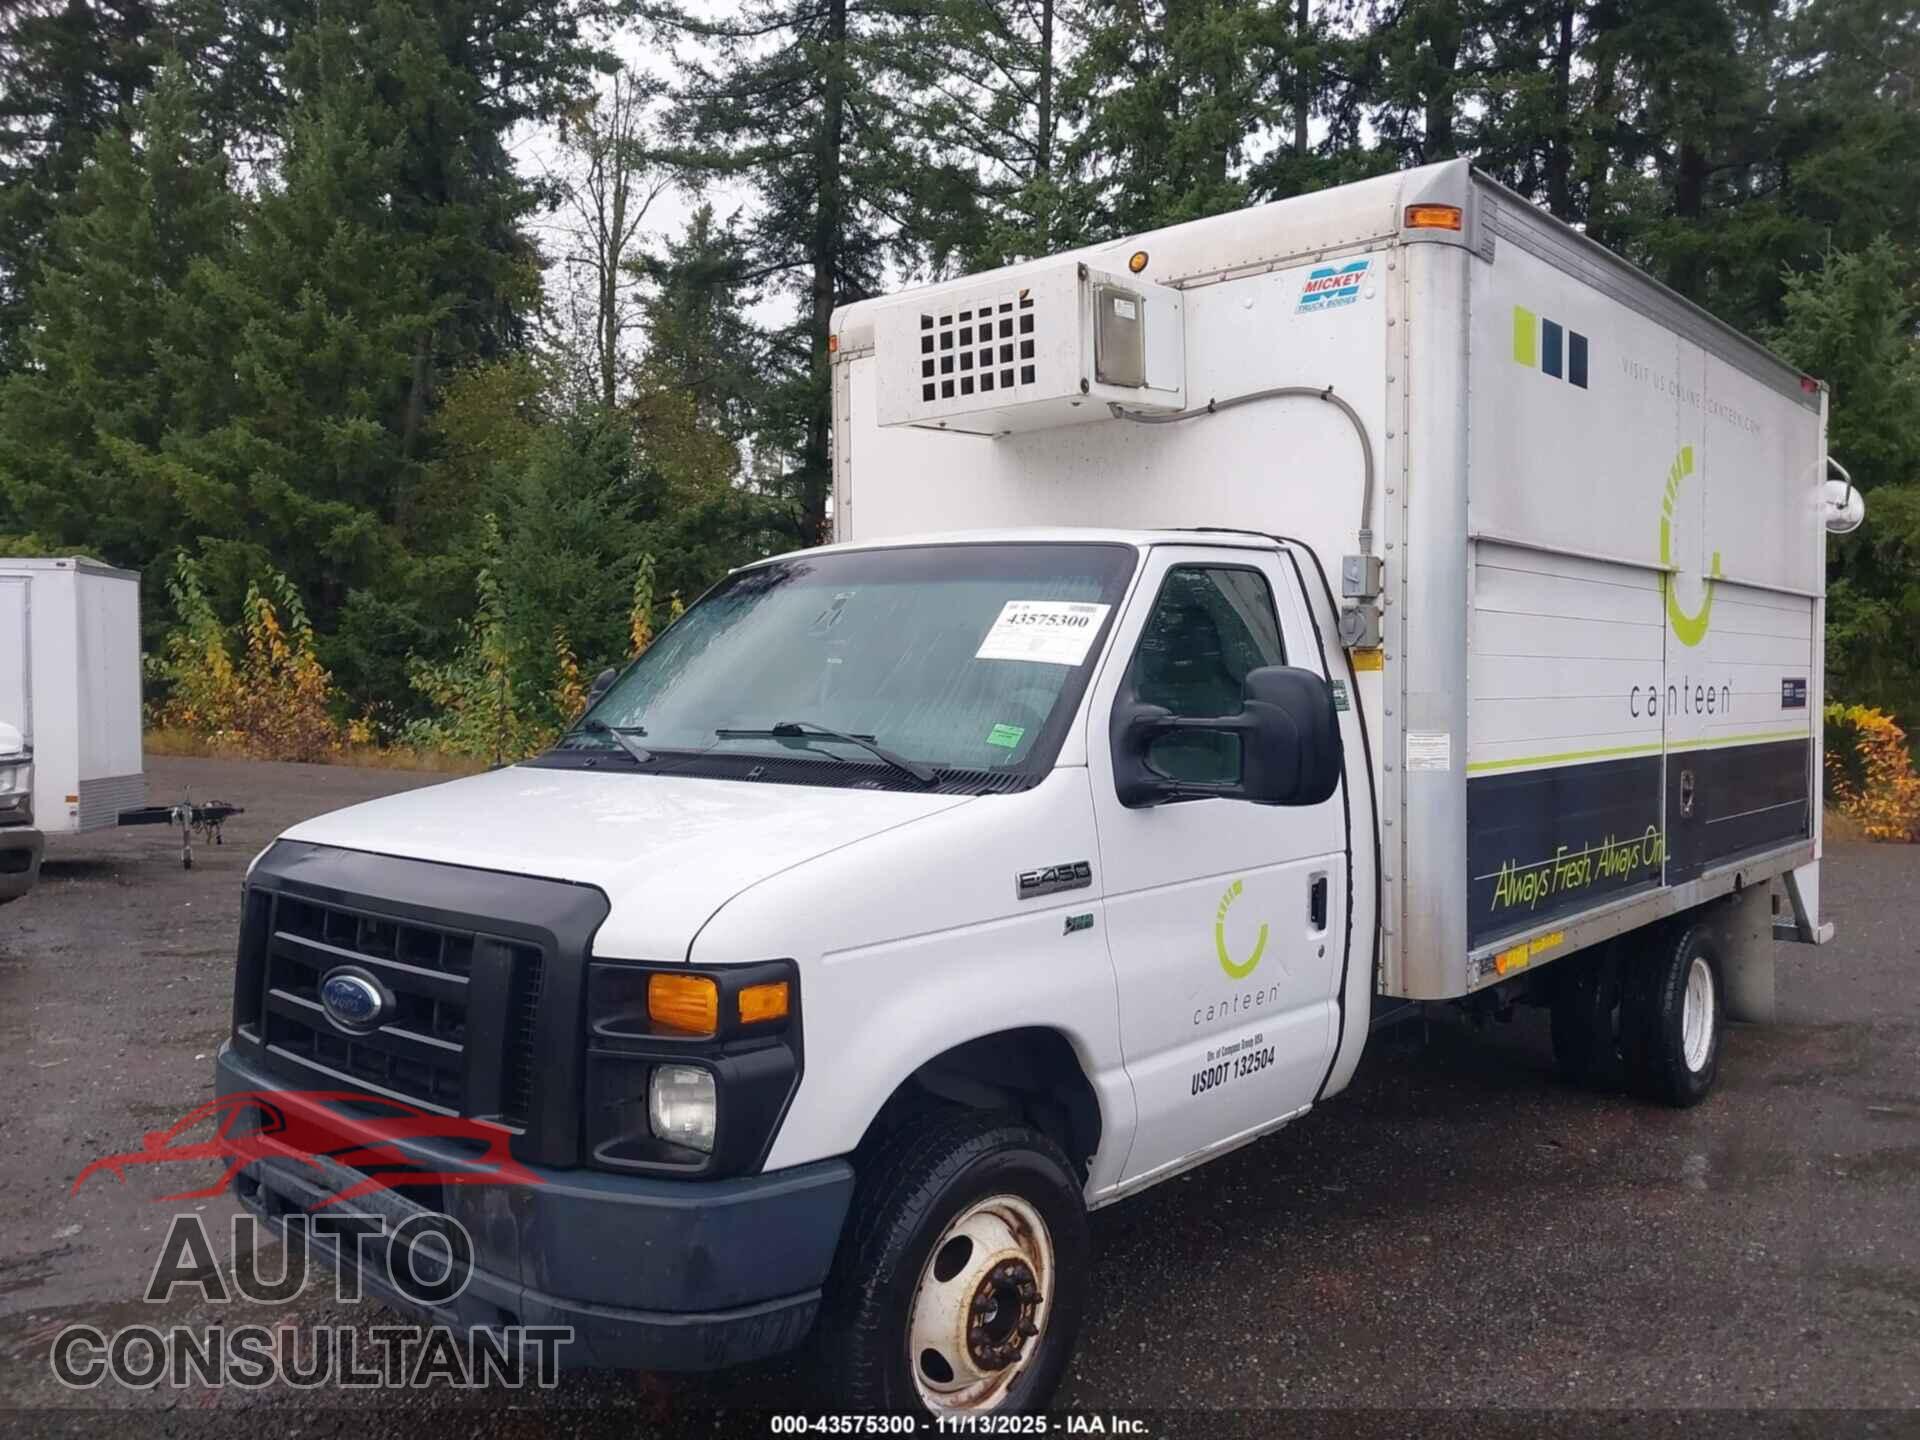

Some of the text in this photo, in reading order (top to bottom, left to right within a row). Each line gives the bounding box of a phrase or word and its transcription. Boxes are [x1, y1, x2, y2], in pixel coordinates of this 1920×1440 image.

[1304, 271, 1365, 292] MICKEY
[1622, 356, 1649, 381] VISIT
[1654, 370, 1665, 392] US
[1007, 612, 1090, 629] 43575300
[1630, 674, 1731, 718] canteen
[1491, 857, 1549, 912] Always
[1552, 845, 1592, 893] Fresh,
[1595, 833, 1640, 882] Always
[1193, 984, 1278, 1025] canteen
[1222, 1042, 1241, 1056] Compass
[1191, 1045, 1275, 1096] USDOT 132504
